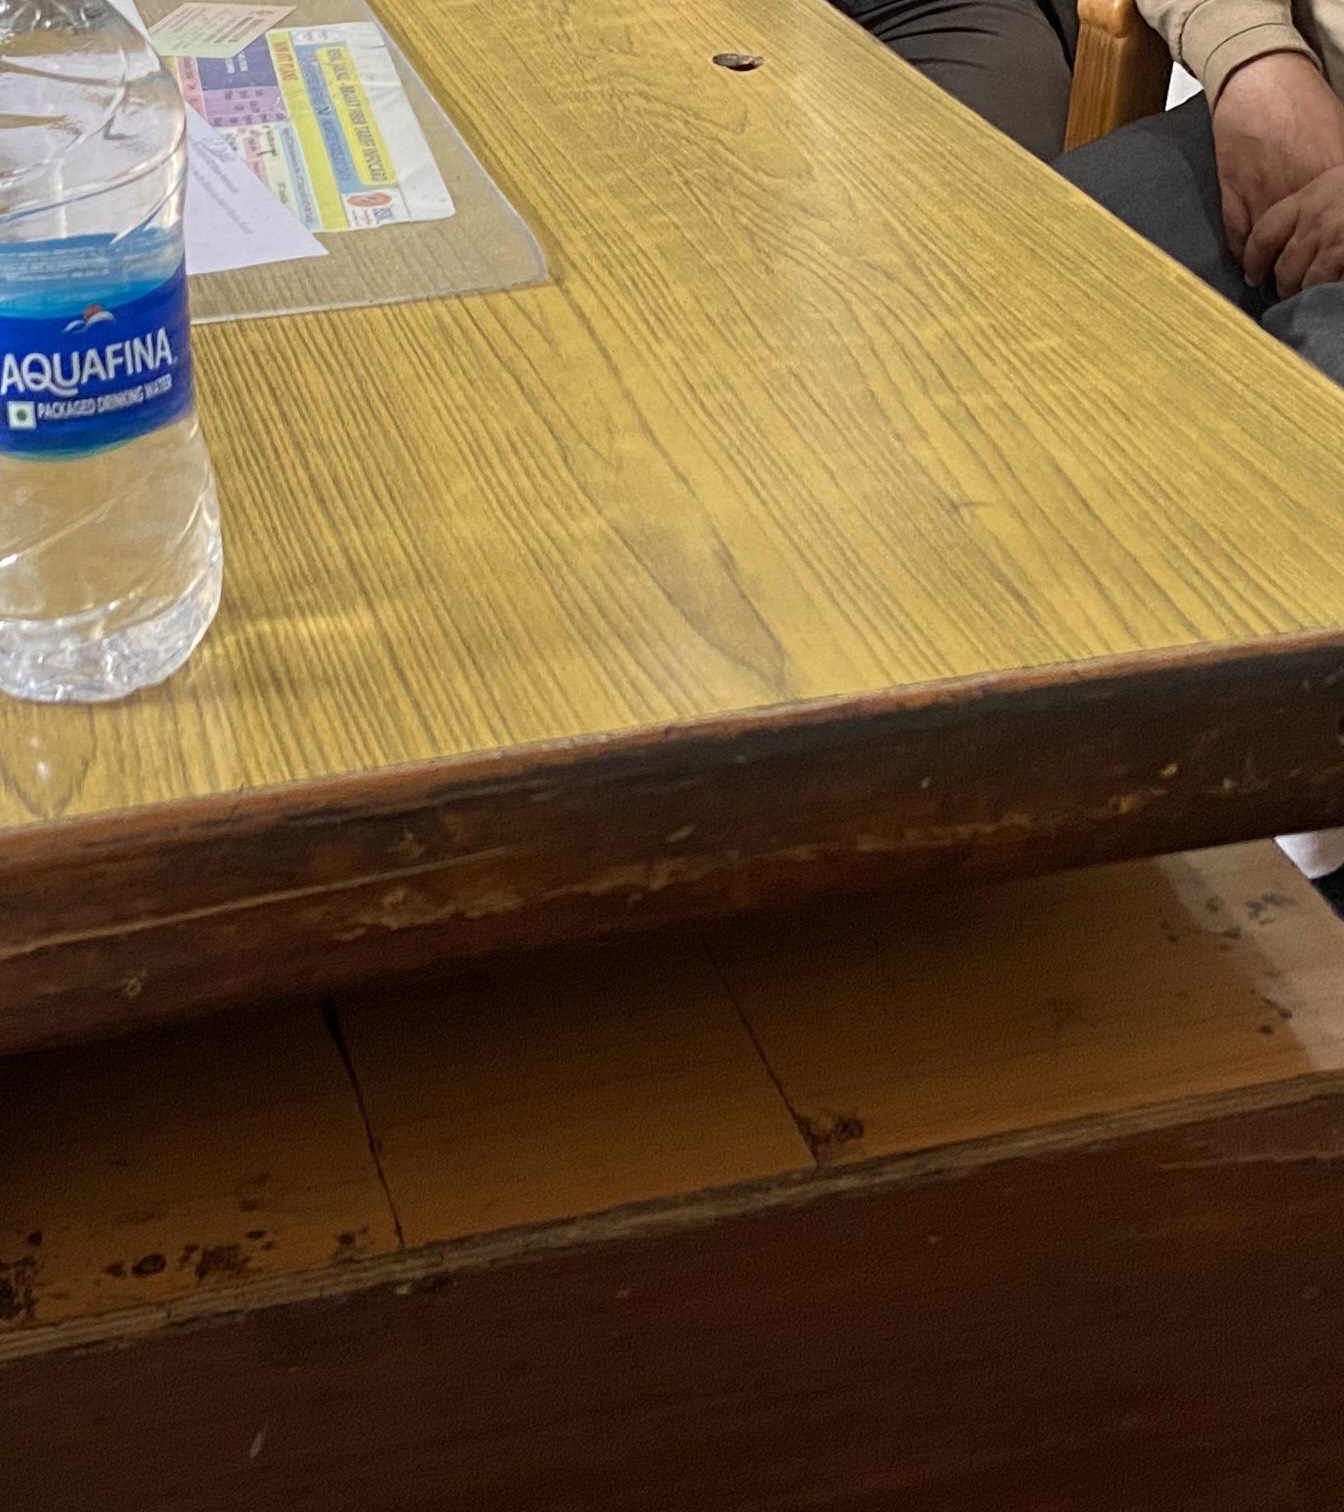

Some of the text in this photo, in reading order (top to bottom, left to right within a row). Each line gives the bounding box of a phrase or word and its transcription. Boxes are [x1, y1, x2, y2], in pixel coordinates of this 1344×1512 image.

[0, 327, 173, 398] AQUAFINA
[37, 373, 173, 420] PACKAGED DRINKING WATER
